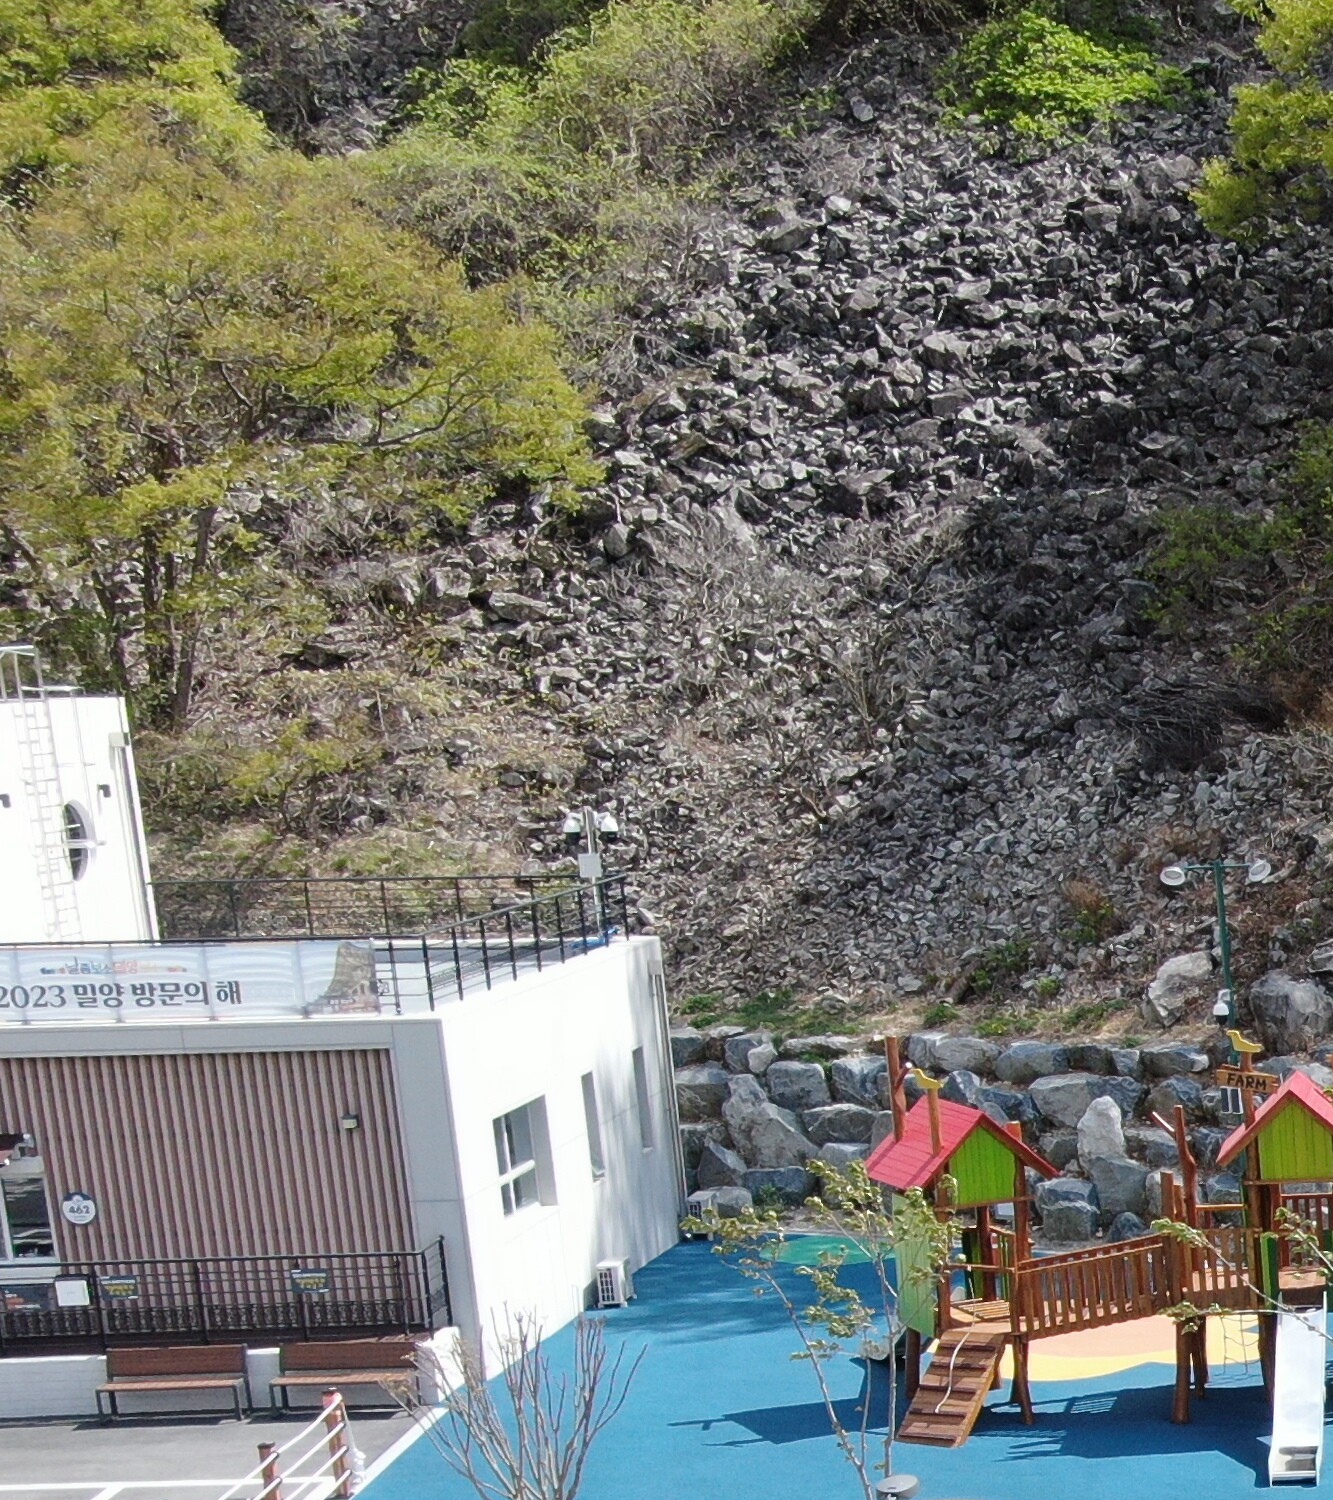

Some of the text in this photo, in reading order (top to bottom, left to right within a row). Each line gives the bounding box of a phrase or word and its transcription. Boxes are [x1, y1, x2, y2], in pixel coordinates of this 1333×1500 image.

[0, 980, 242, 1009] 2023 밀양 방문의 해
[1227, 1073, 1267, 1091] FARM
